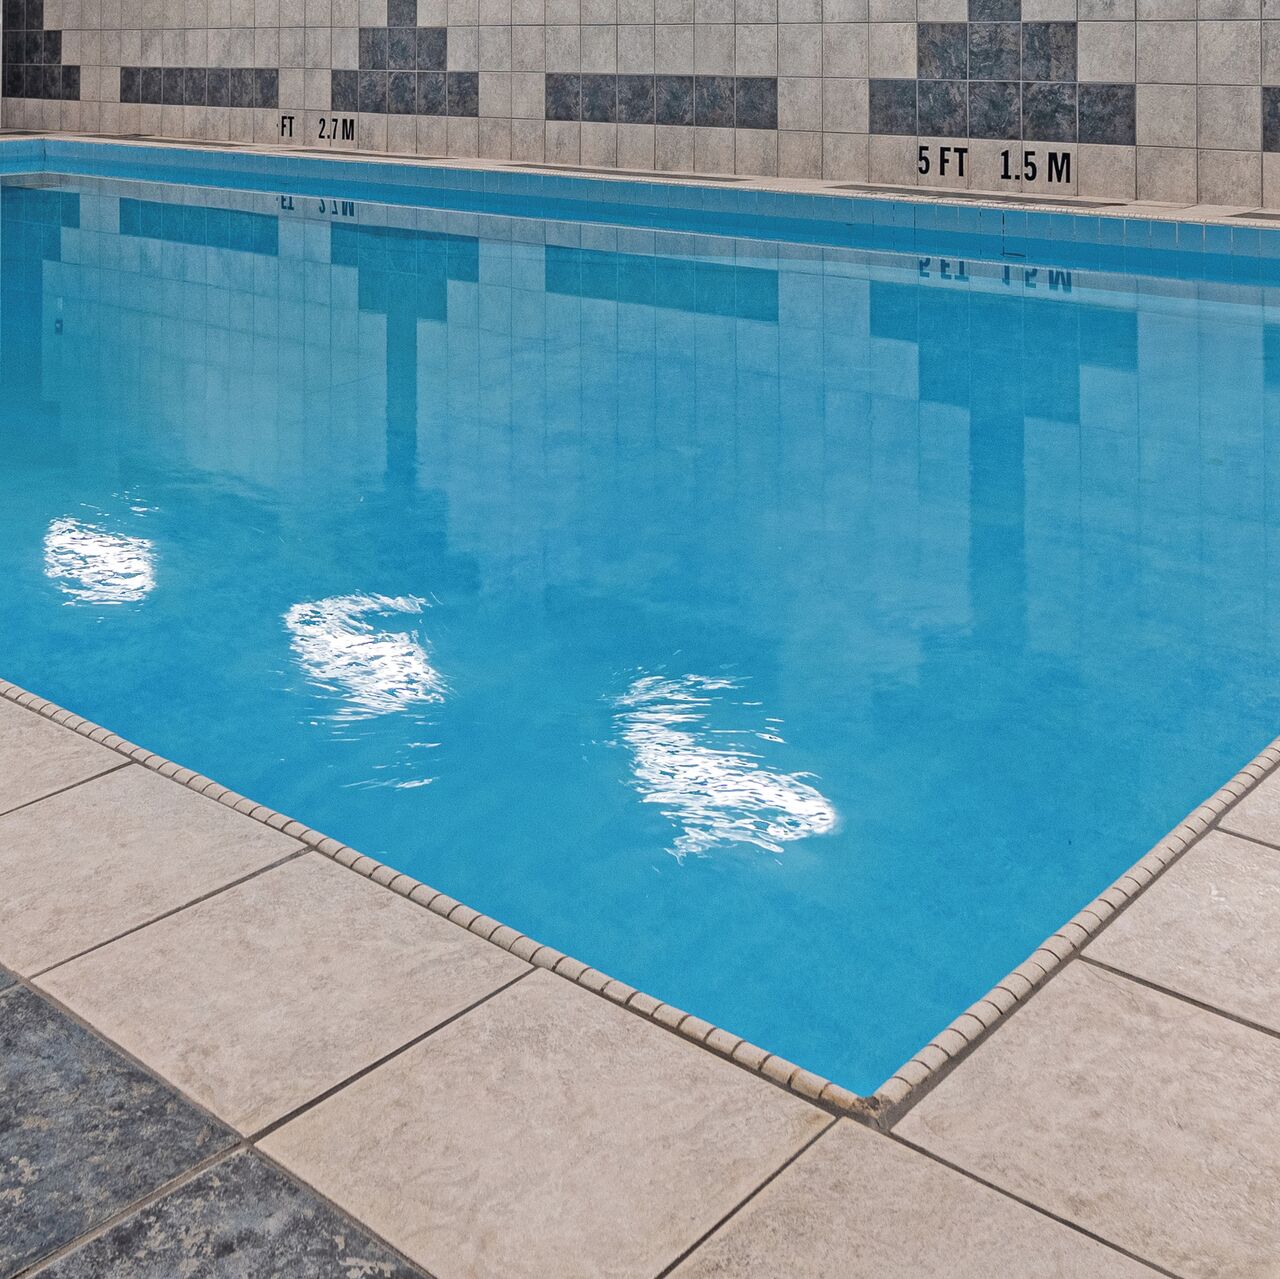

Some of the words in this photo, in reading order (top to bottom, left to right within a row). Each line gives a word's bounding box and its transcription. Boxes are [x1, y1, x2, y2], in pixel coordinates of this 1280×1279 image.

[281, 116, 295, 137] FT
[318, 118, 338, 139] 2.7
[342, 118, 354, 141] M
[918, 145, 930, 175] 5
[939, 147, 968, 177] FT
[1001, 149, 1037, 181] 1.5
[1048, 152, 1070, 183] M
